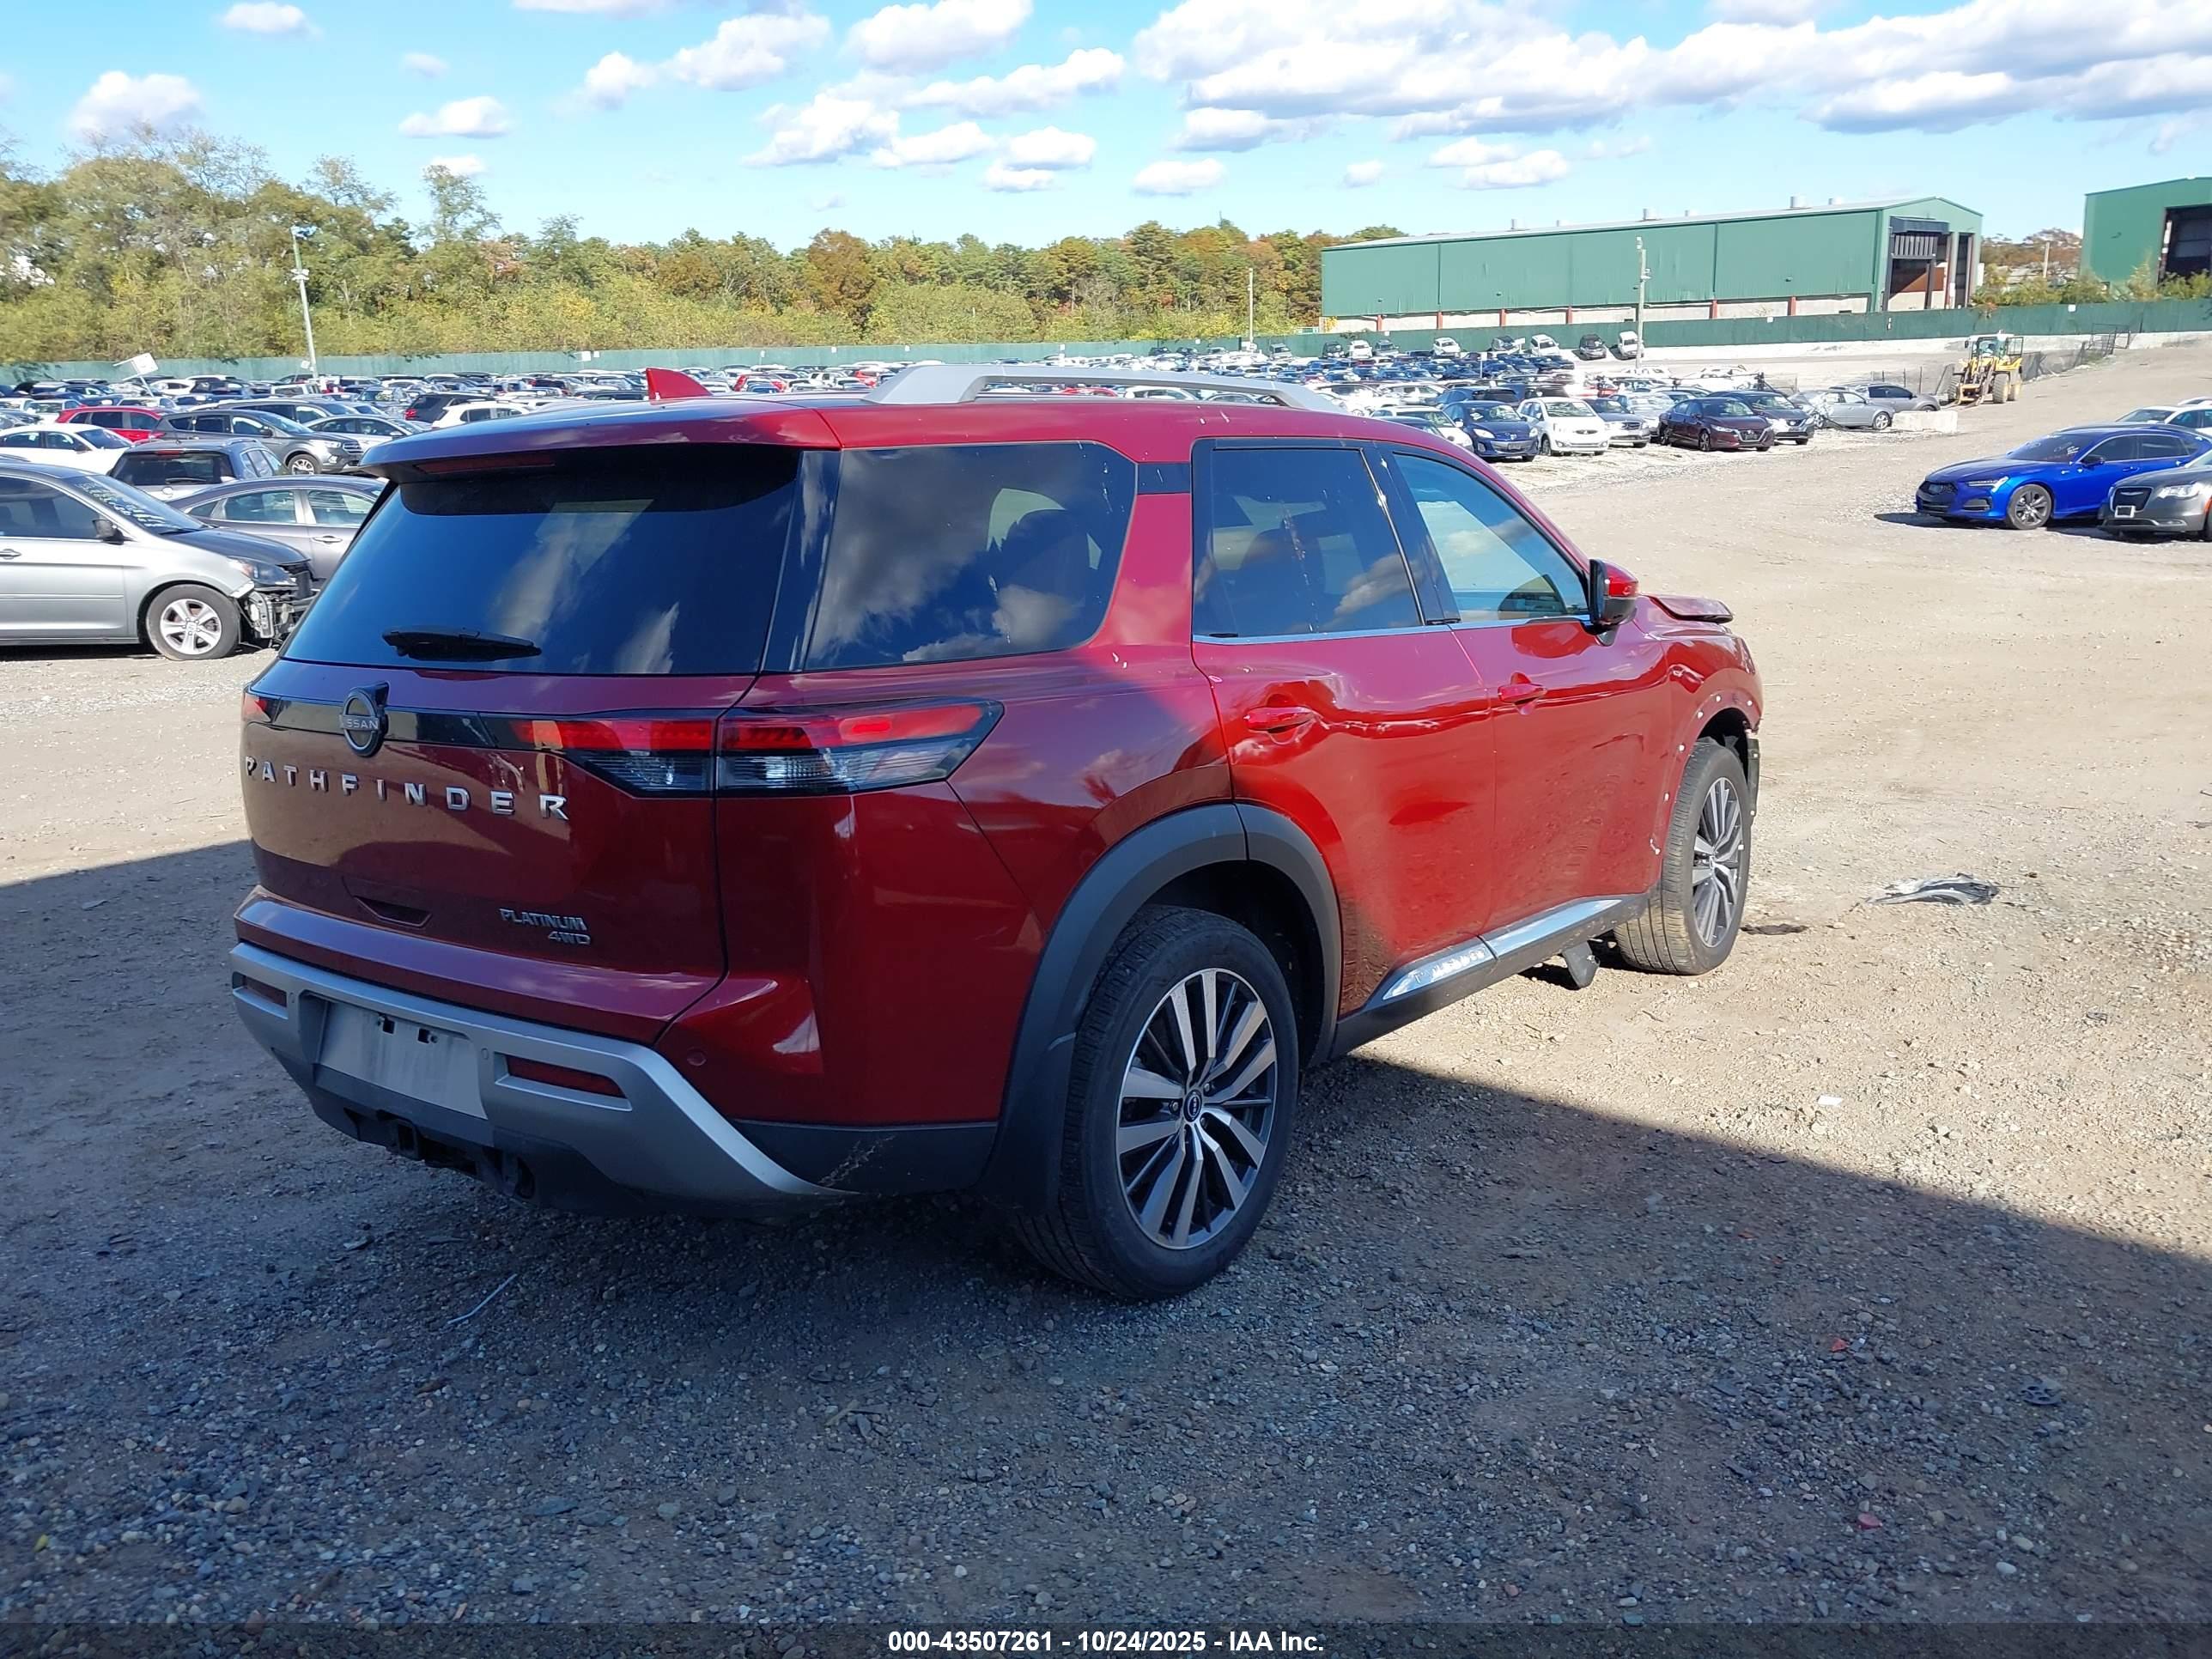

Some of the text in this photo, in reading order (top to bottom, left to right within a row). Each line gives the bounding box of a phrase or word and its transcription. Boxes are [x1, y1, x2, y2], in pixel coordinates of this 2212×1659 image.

[341, 717, 379, 730] SSAN
[244, 756, 569, 821] PATHFINDER
[499, 908, 588, 931] PLATINUM
[548, 931, 591, 945] 4WD
